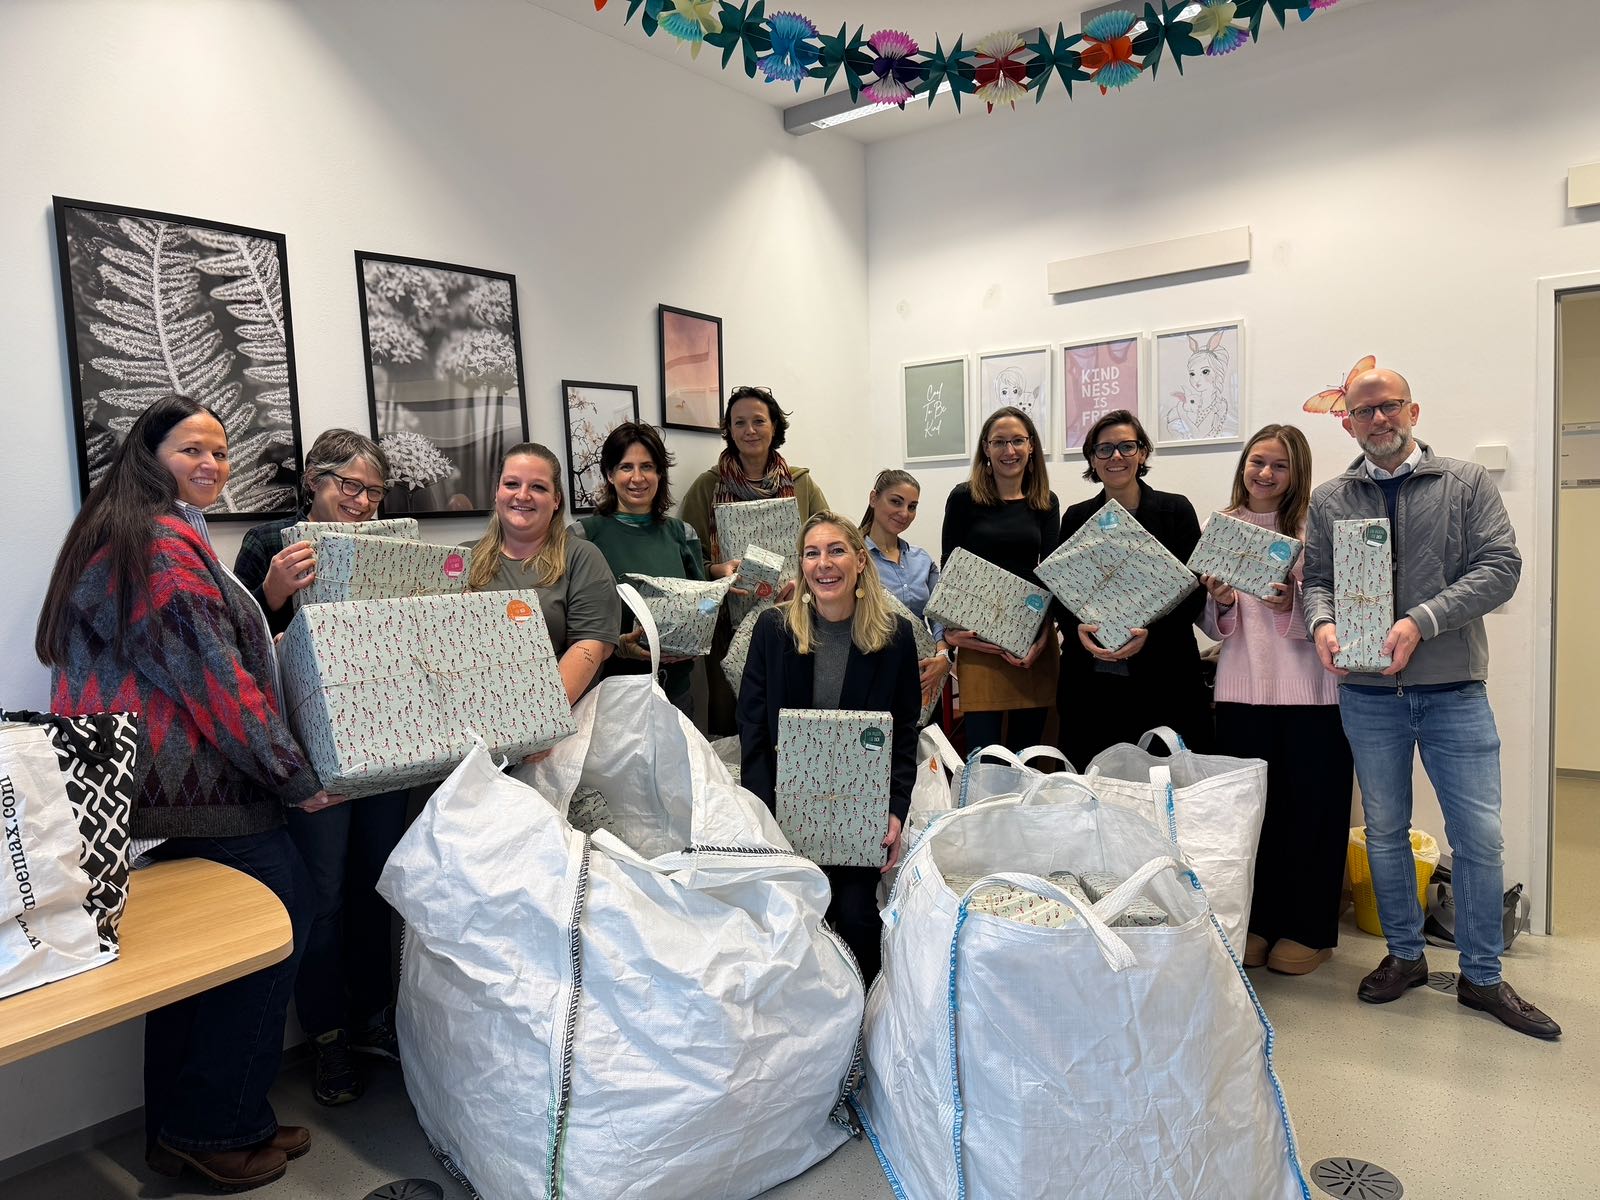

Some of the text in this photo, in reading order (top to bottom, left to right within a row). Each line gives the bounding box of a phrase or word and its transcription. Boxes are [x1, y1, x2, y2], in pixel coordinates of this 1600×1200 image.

[1081, 366, 1120, 384] KIND
[1081, 381, 1121, 398] NESS
[1093, 397, 1108, 409] IS
[1081, 408, 1120, 427] FR
